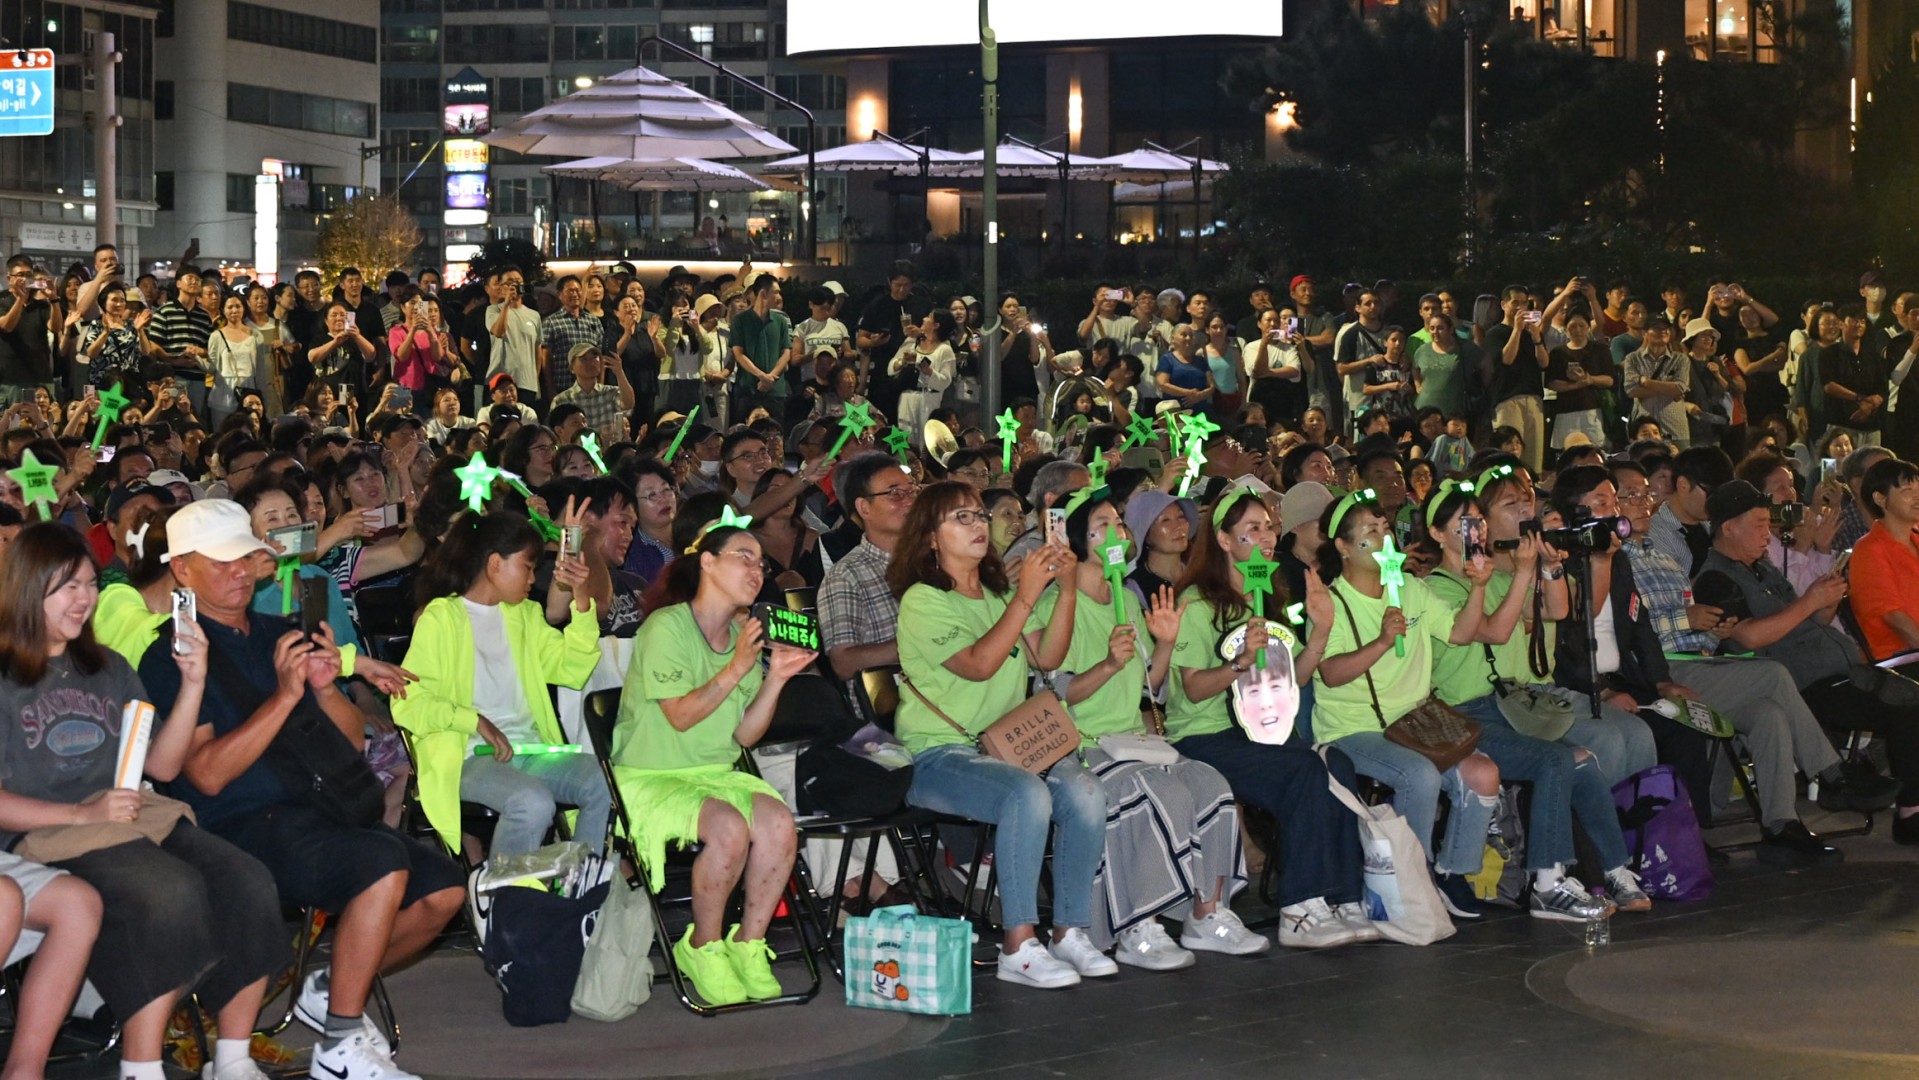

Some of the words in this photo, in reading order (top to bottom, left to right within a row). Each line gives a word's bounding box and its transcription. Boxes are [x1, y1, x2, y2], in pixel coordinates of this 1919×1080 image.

[0, 78, 26, 97] 이길
[777, 623, 809, 647] 나태주
[1005, 708, 1053, 744] BRILLA
[1013, 730, 1046, 756] COME
[1044, 720, 1061, 735] UN
[1021, 732, 1069, 769] CRISTALLO
